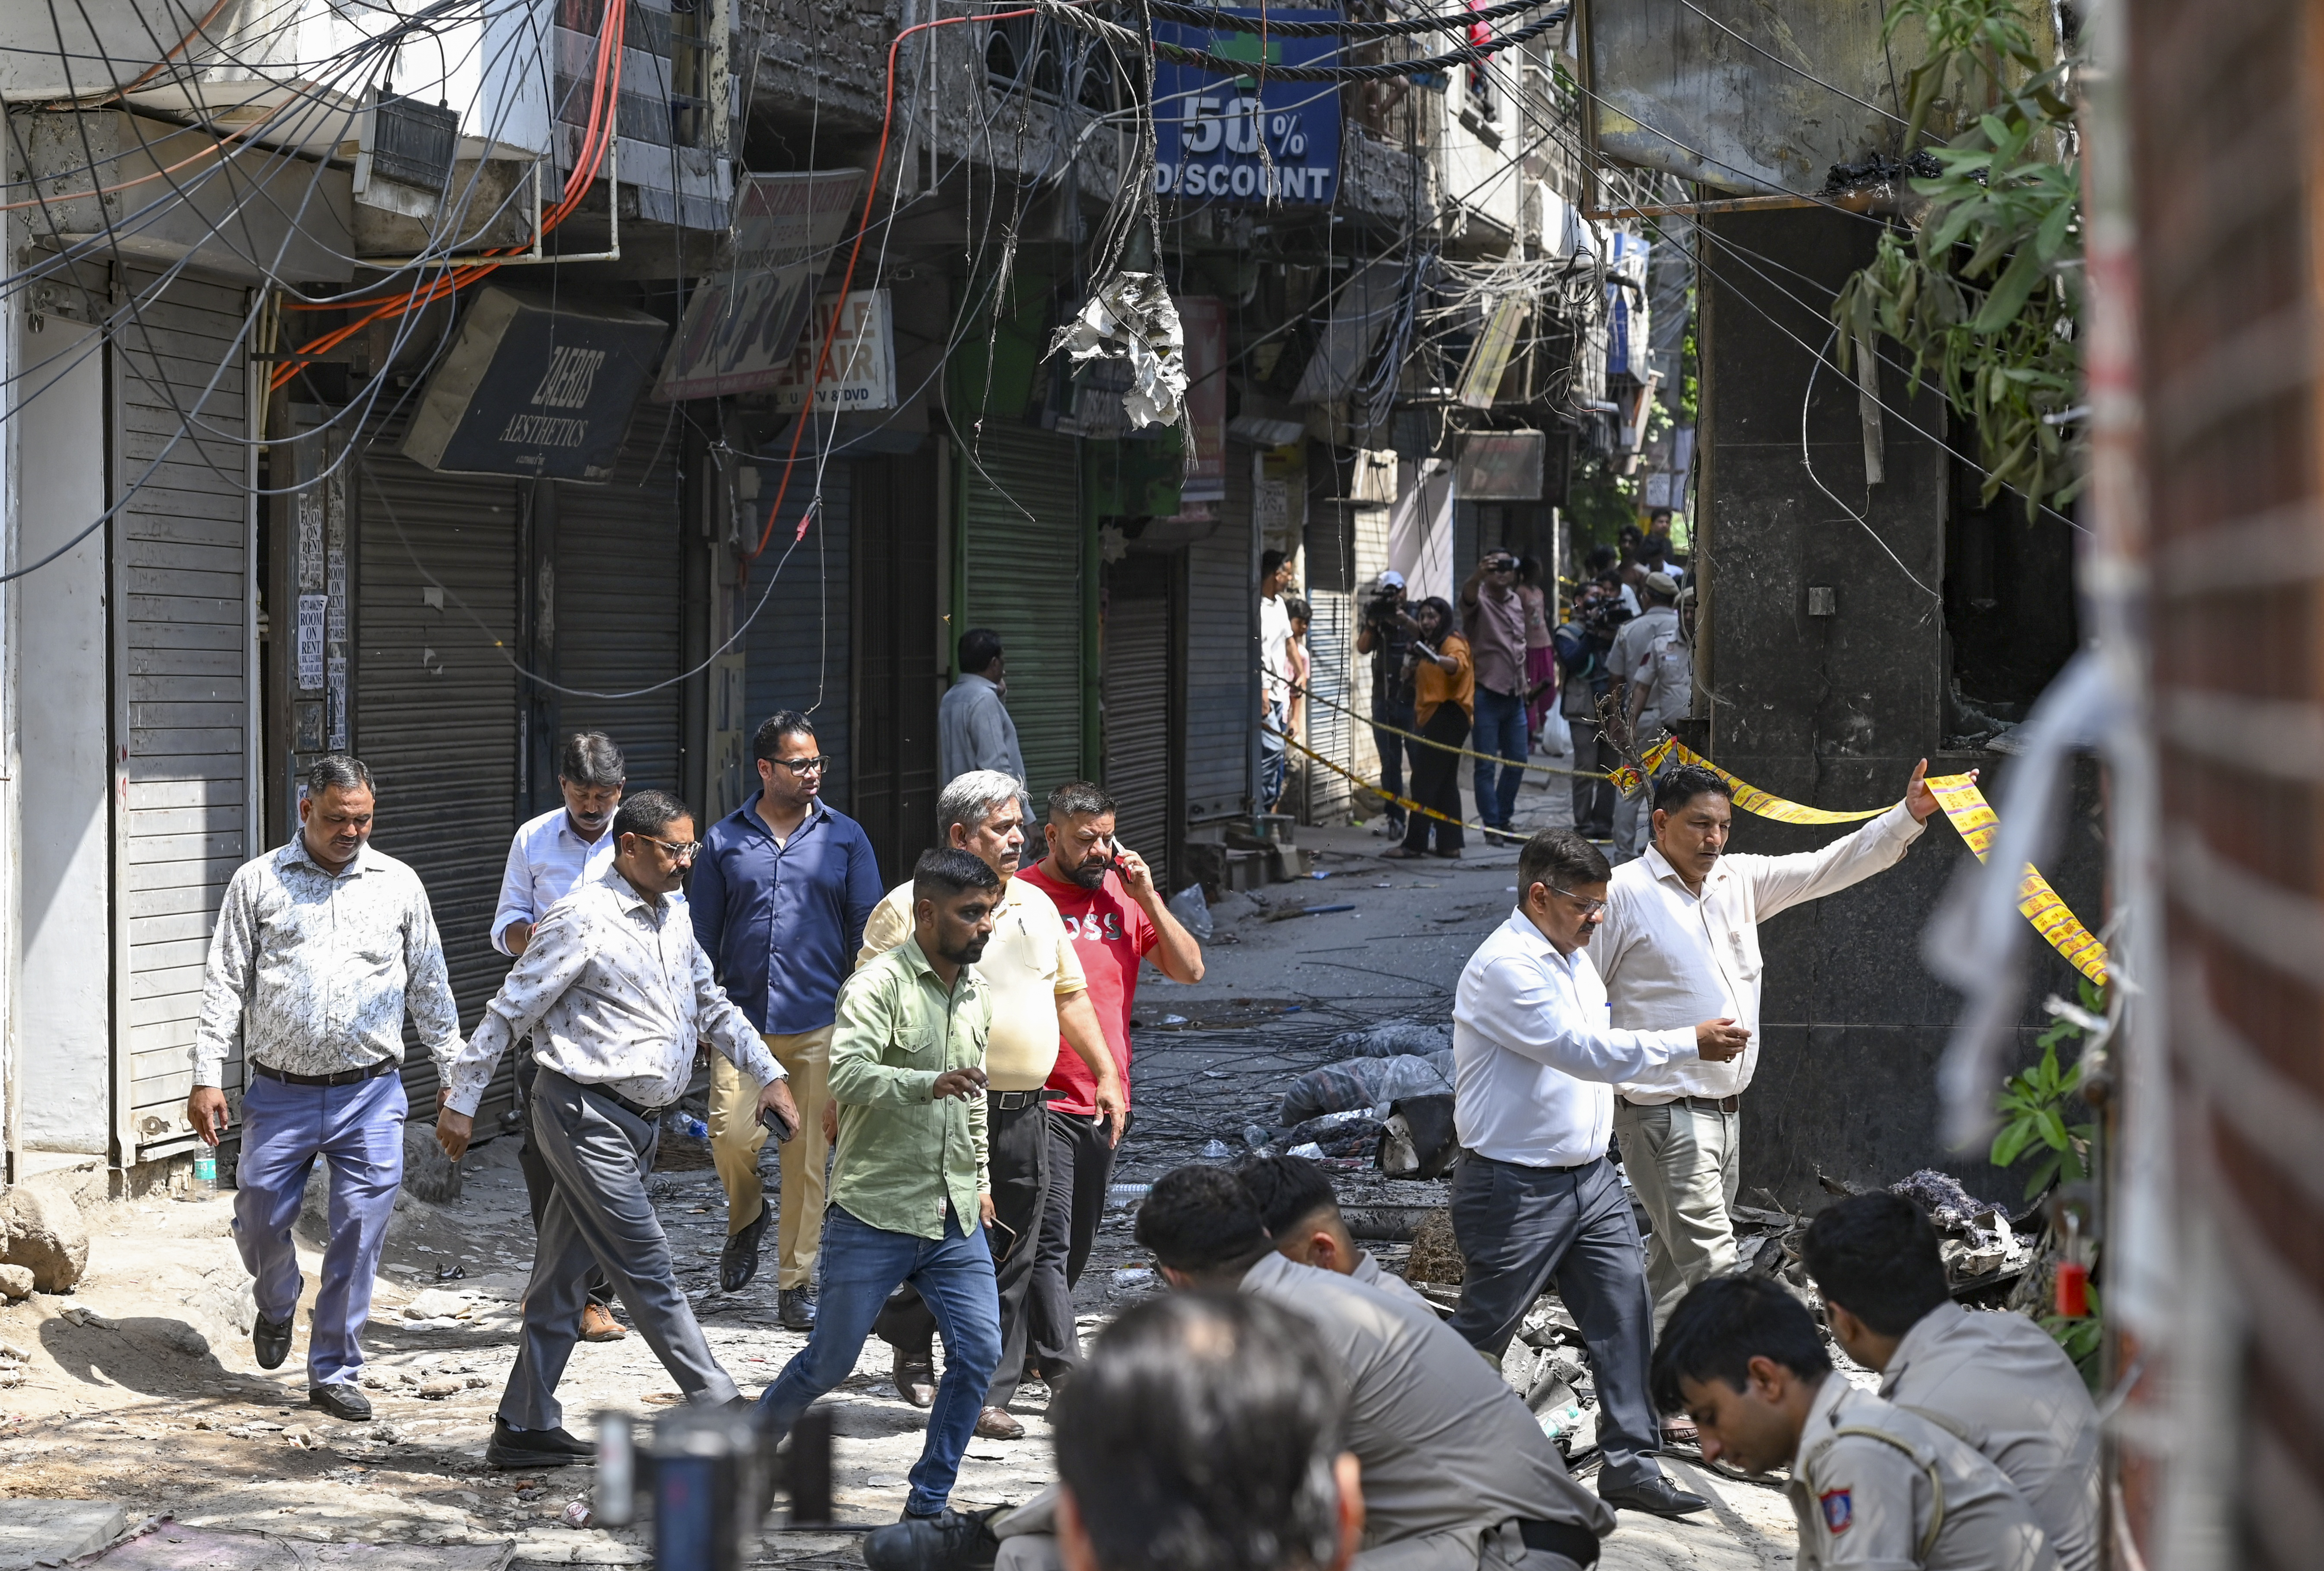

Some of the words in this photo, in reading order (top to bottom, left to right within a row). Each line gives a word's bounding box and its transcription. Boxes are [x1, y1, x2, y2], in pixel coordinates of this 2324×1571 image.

[1155, 162, 1329, 199] DISCOUNT
[799, 301, 875, 342] BILE
[780, 343, 875, 386] PAIR
[531, 346, 605, 409] ZAEBOS
[831, 390, 839, 402] &
[844, 388, 869, 402] DVD
[499, 413, 588, 447] AESTHETICS
[332, 581, 340, 595] ON
[328, 595, 344, 608] RENT
[300, 613, 322, 626] ROOM
[306, 627, 317, 640] ON
[302, 641, 321, 654] RENT
[305, 664, 322, 673] AVAILABLE
[1060, 912, 1122, 940] OSS
